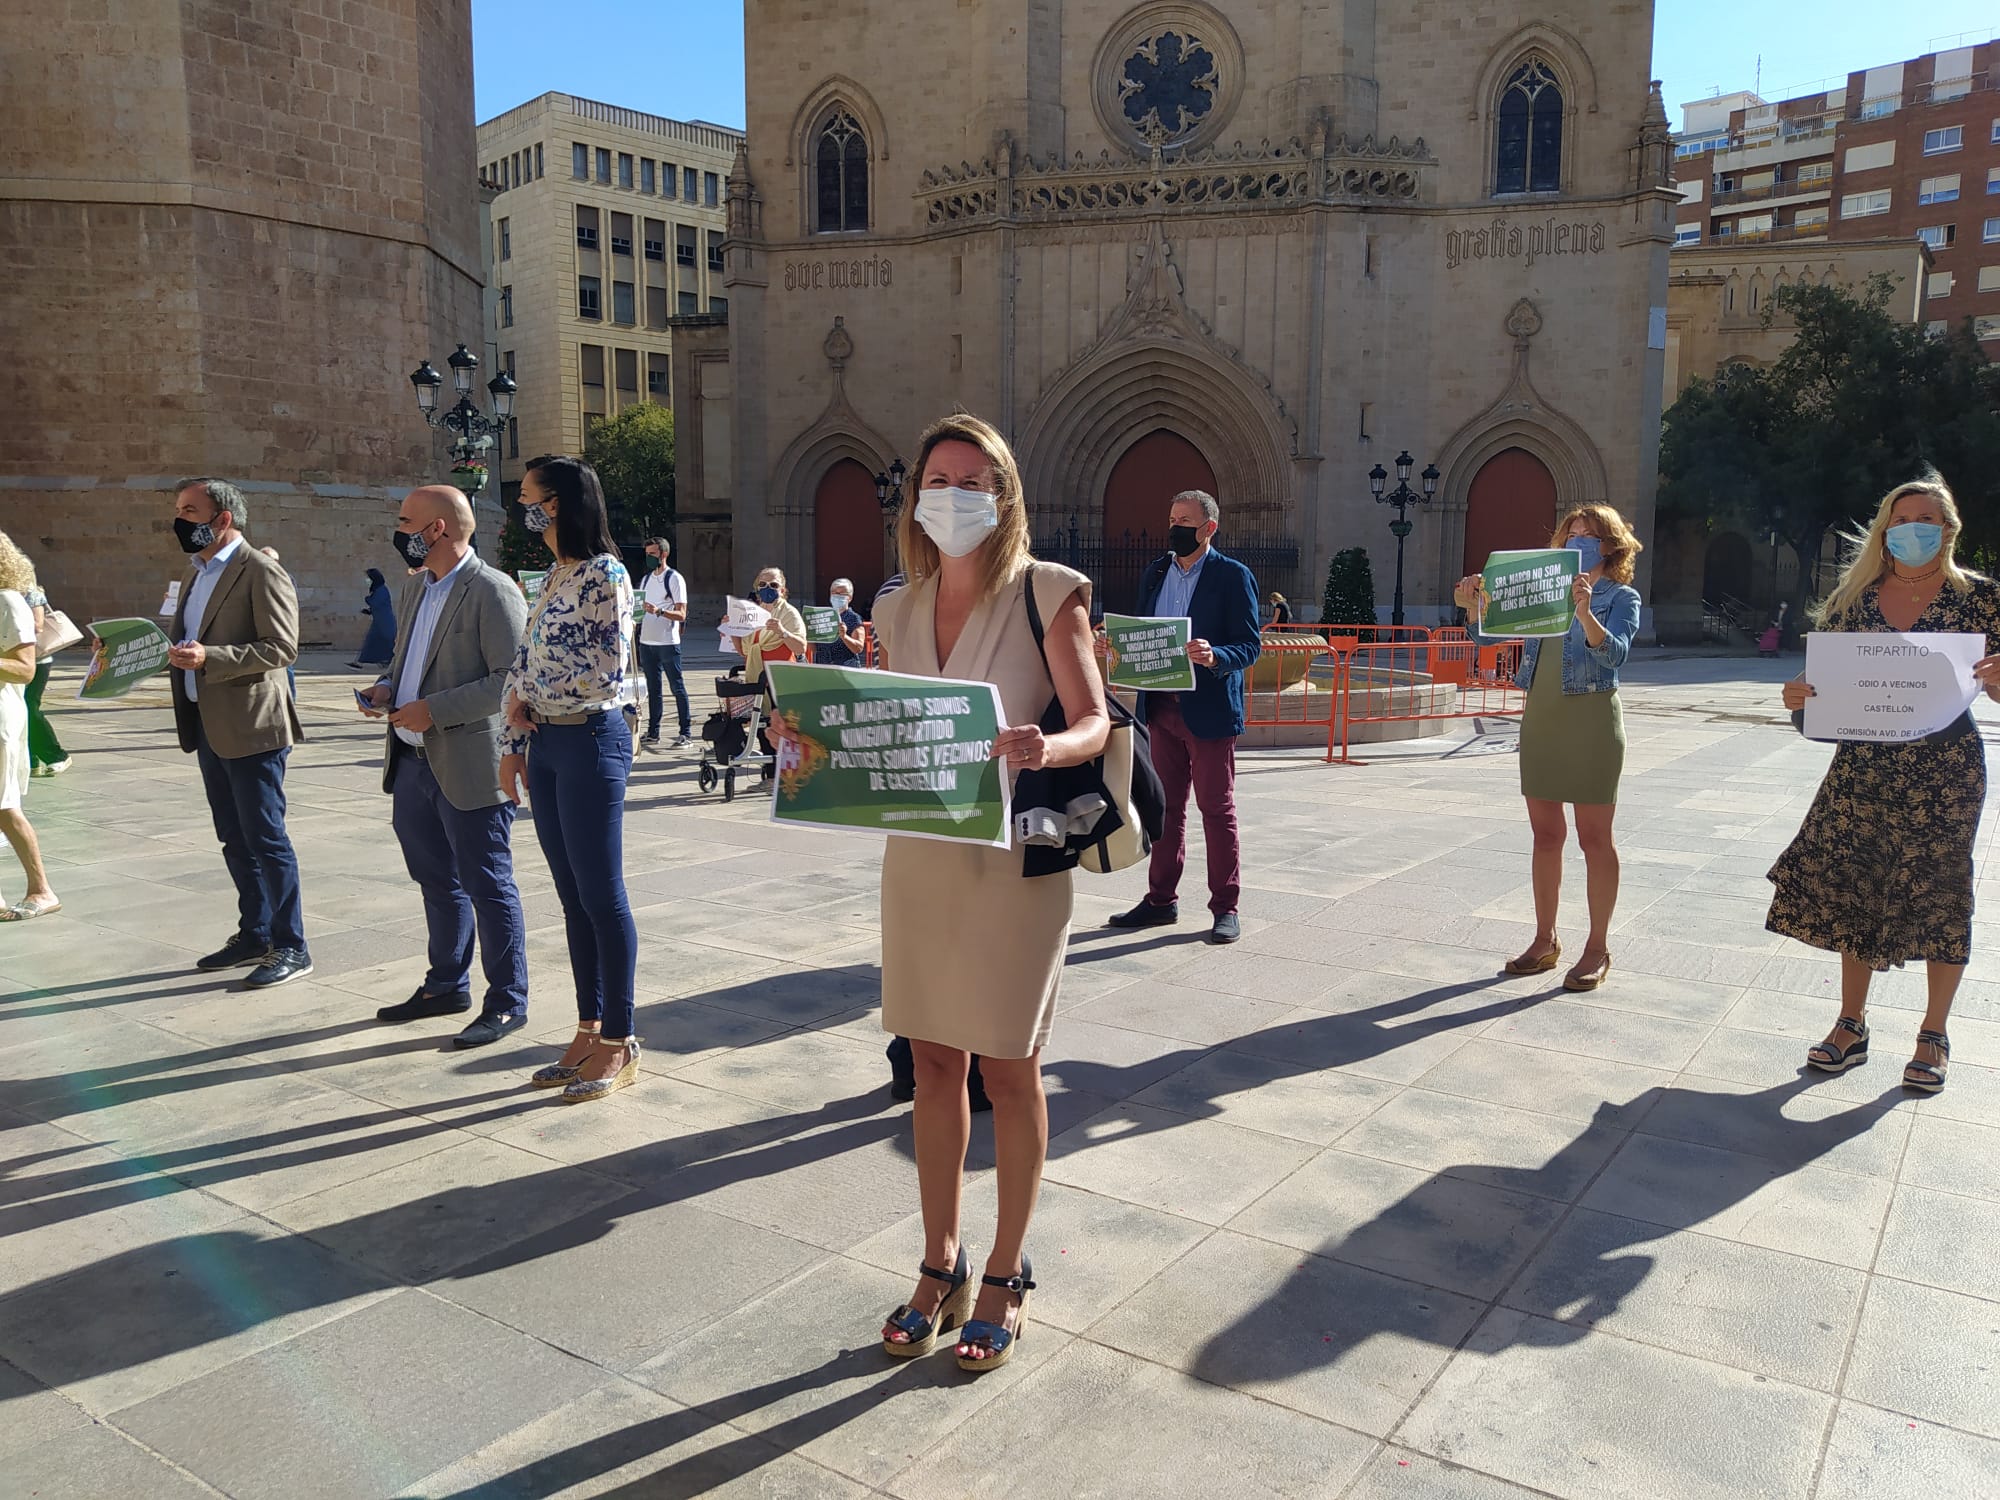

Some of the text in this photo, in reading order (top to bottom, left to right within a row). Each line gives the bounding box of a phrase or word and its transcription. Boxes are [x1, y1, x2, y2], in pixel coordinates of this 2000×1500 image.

[1525, 217, 1605, 268] plena
[829, 253, 892, 288] maria
[1510, 570, 1531, 585] MARCO
[1532, 568, 1542, 579] NO
[1544, 563, 1561, 576] SOM
[1492, 590, 1503, 601] CAP
[1504, 583, 1524, 598] PARTIT
[1556, 574, 1572, 587] SOM
[1519, 596, 1527, 608] DE
[1129, 631, 1146, 641] MARCO
[1147, 629, 1155, 639] NO
[1156, 625, 1176, 638] SOMOS
[1144, 638, 1167, 650] PARTIDO
[1856, 645, 1929, 657] TRIPARTITO
[1141, 650, 1159, 661] SOMOS
[1160, 646, 1183, 658] VECINOS
[1135, 663, 1141, 672] DE
[1858, 680, 1879, 688] ODIO
[1881, 680, 1888, 688] A
[1890, 680, 1927, 689] VECINOS
[853, 699, 901, 723] MARCO
[904, 698, 922, 718] NO
[924, 696, 970, 716] SOMOS
[1864, 704, 1914, 713] CASTELLÓN
[895, 719, 955, 744] PARTIDO
[1837, 727, 1877, 737] COMISIÓN
[1879, 729, 1898, 738] AVD.
[882, 746, 930, 770] SOMOS
[933, 739, 993, 766] VECINOS
[869, 766, 957, 791] DE CASTELLÓN
